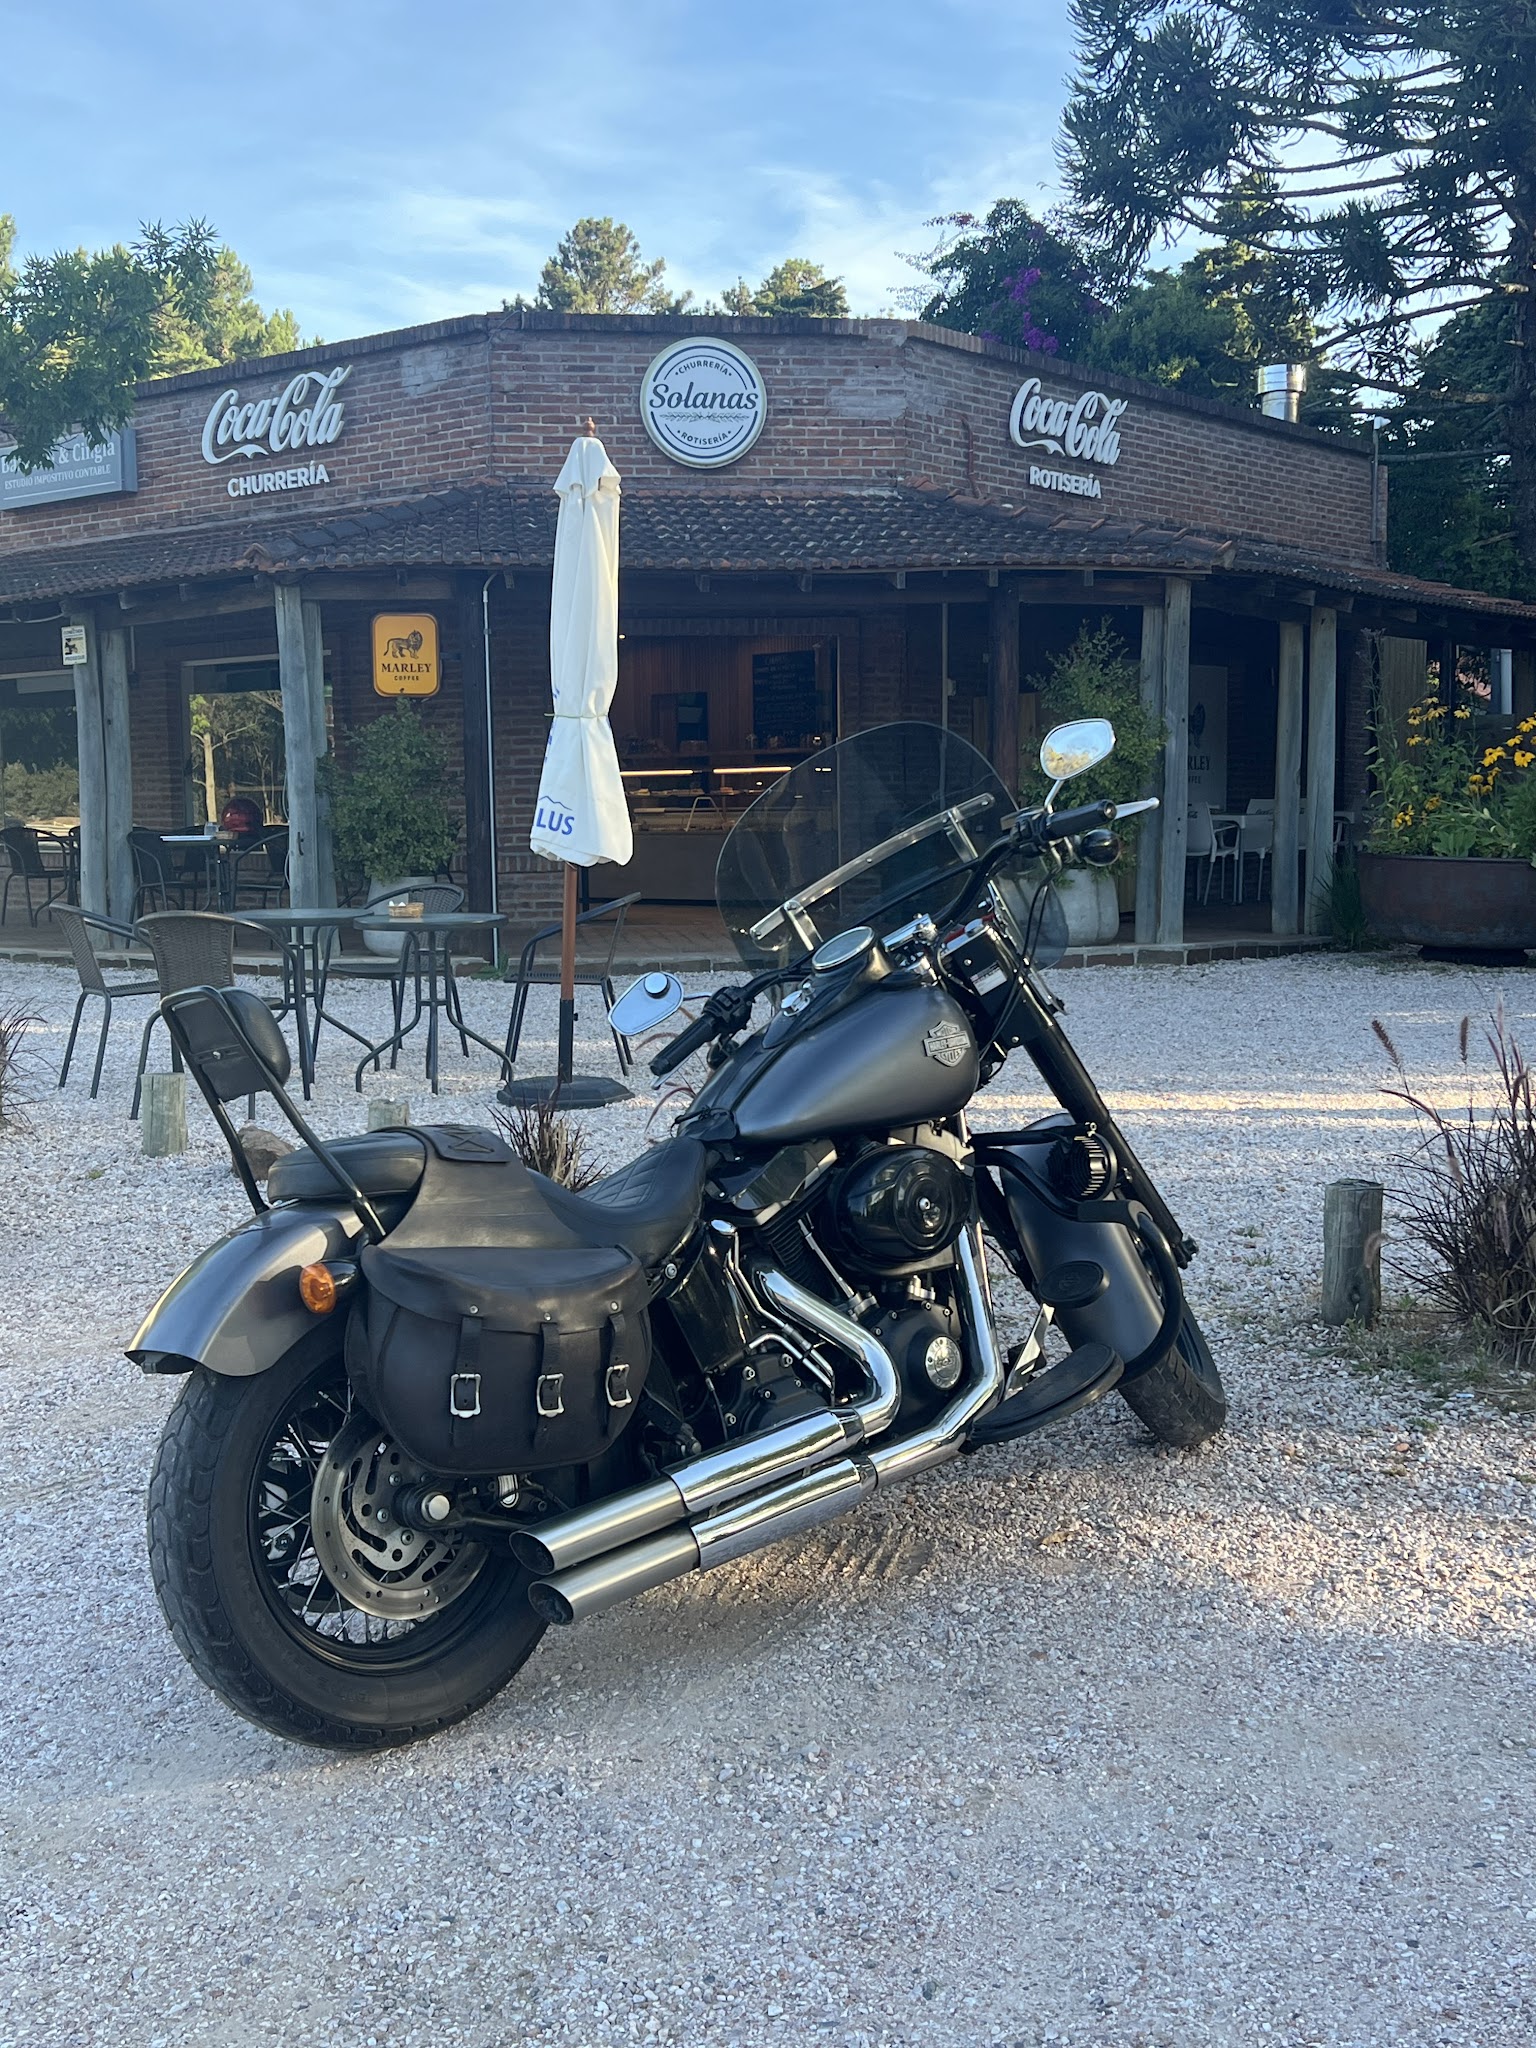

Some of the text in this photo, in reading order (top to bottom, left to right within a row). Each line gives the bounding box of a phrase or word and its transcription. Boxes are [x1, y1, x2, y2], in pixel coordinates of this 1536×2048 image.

[678, 360, 728, 376] CHURRERÍA
[649, 382, 758, 410] Solanas
[202, 365, 353, 464] Coca-Cola
[1009, 378, 1128, 465] Coca-Cola
[681, 431, 729, 446] ROTISERÍA
[5, 464, 111, 490] ESTUDIO IMPOSITIVO CONTABLE
[227, 460, 331, 498] CHURRERÍA
[1029, 465, 1102, 499] ROTISERÍA
[381, 663, 431, 673] MARLEY
[536, 808, 575, 836] LUS
